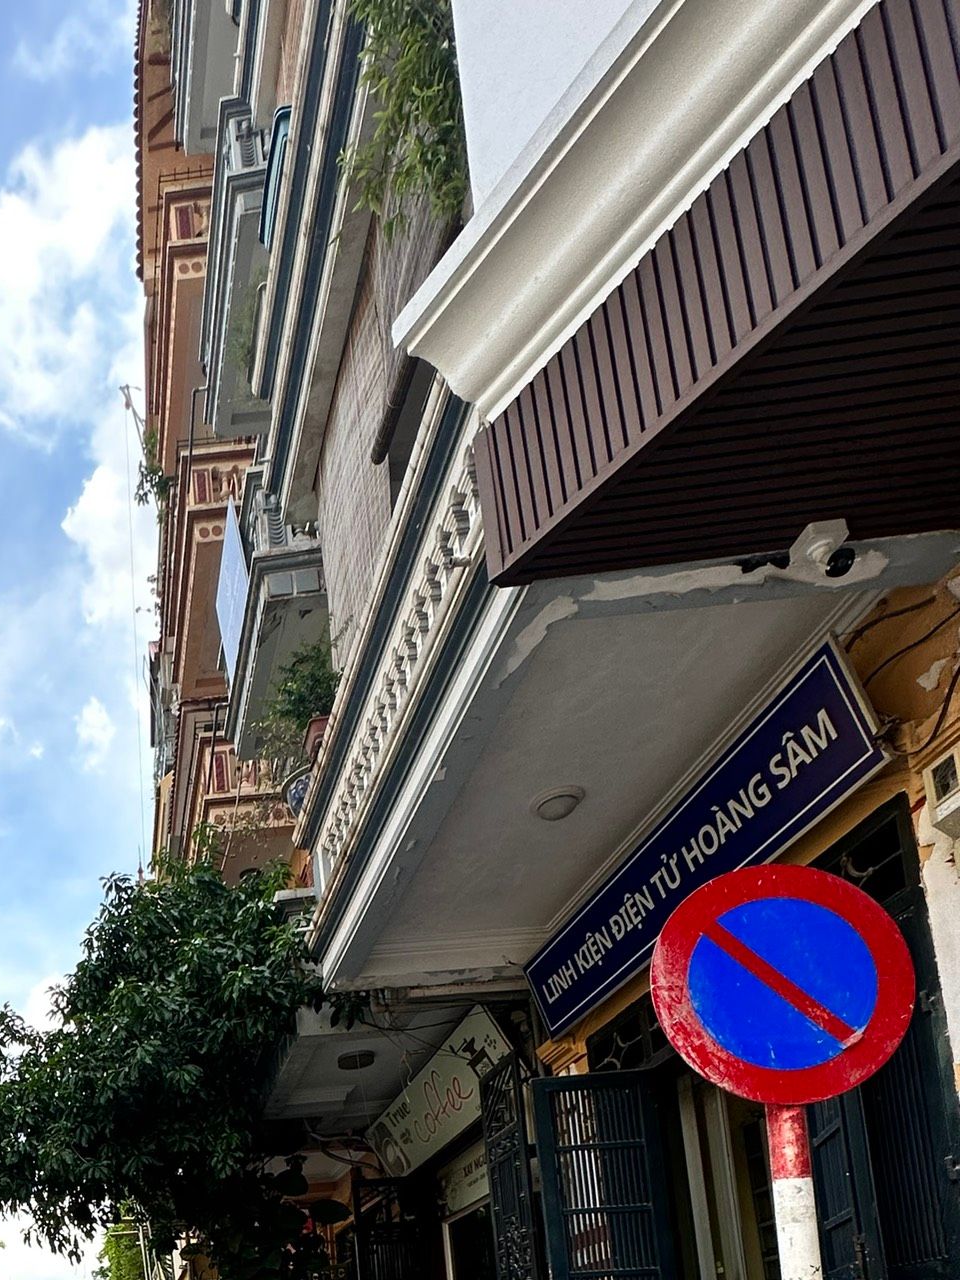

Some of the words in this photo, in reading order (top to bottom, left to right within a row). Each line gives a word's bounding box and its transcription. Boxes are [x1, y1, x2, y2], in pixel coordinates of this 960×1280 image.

[541, 958, 578, 1006] LINH
[574, 930, 615, 981] KIỆN
[610, 884, 657, 942] ĐIỆN
[649, 850, 683, 899] TỬ
[681, 770, 773, 872] HOÀNG
[769, 706, 840, 790] SÂM
[384, 1101, 412, 1128] True
